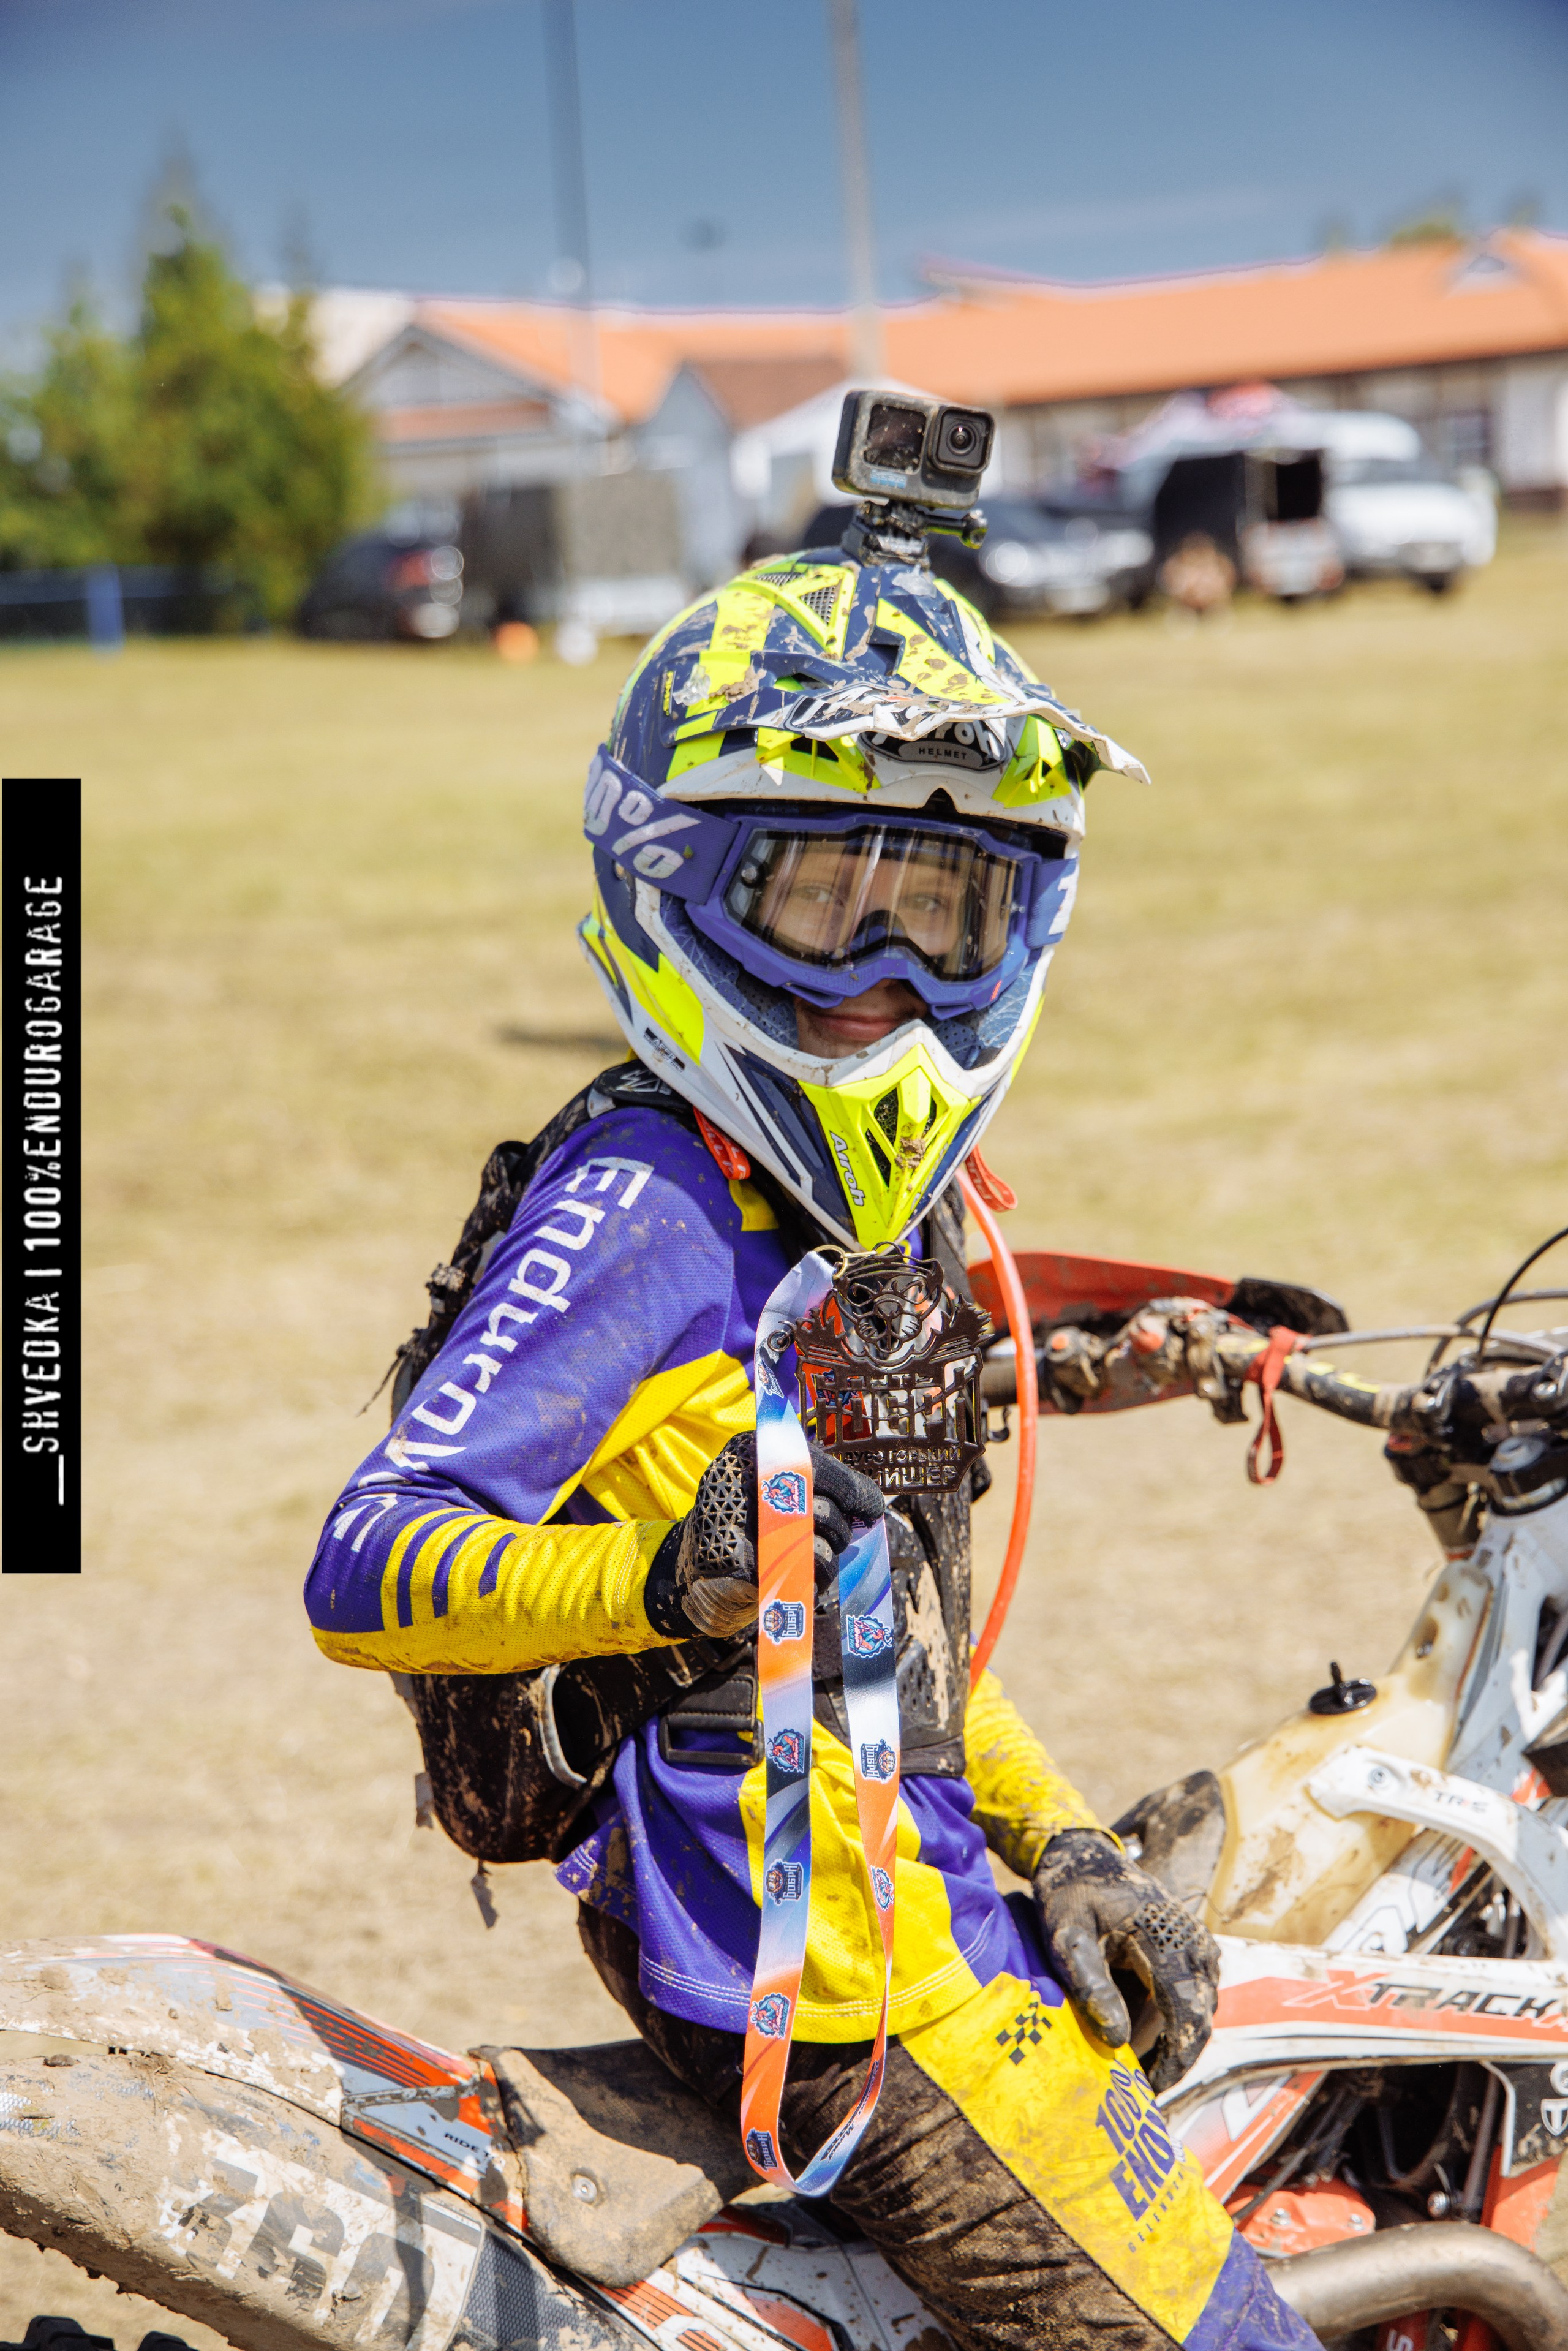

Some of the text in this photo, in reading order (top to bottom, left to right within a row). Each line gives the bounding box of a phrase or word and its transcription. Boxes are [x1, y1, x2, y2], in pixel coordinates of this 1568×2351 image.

[919, 747, 967, 760] HELMET
[829, 1130, 865, 1207] Airoh
[888, 1443, 962, 1465] ГОРЬКИЙ
[444, 2133, 480, 2154] RIDE
